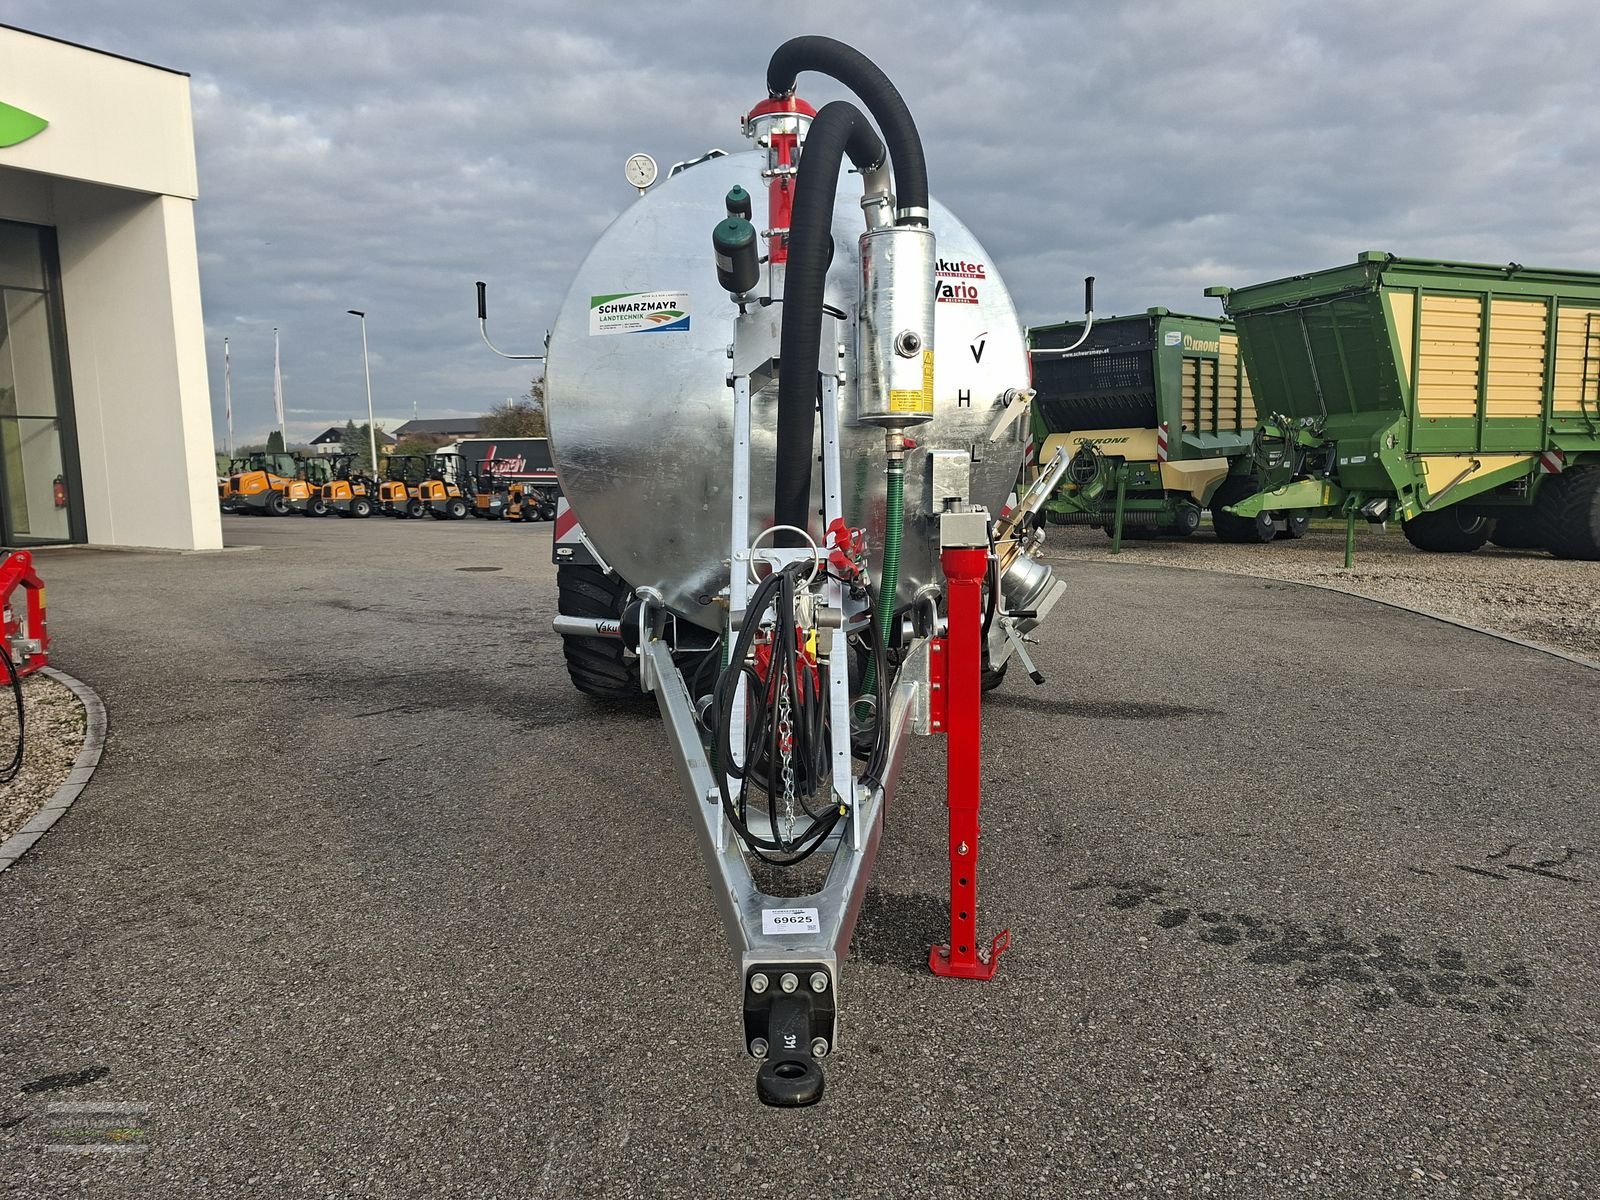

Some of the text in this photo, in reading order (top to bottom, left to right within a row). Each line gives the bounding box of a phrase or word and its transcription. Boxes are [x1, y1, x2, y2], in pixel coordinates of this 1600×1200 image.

[598, 301, 677, 314] SCHWARZMAYR
[599, 314, 644, 322] LANDTECHNIK
[1192, 339, 1219, 353] KRONE
[958, 389, 970, 407] H
[970, 444, 981, 462] L
[774, 916, 813, 924] 69625
